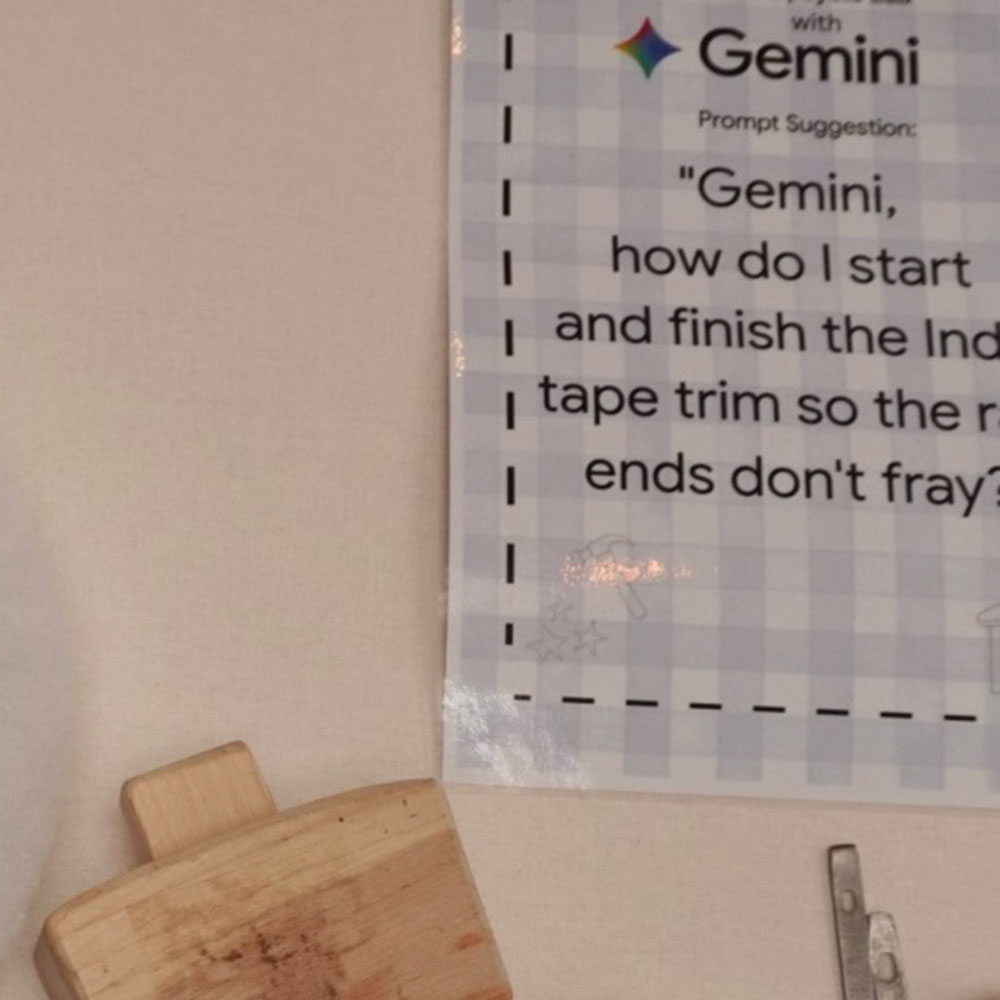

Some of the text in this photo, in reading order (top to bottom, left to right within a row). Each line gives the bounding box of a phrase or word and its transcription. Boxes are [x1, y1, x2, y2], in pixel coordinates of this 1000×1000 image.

[791, 13, 842, 32] with
[699, 26, 919, 86] Gemini
[698, 109, 917, 140] Prompt Suggestion:
[679, 165, 897, 219] "Gemini,
[611, 234, 972, 289] how do I start
[555, 305, 652, 345] and
[667, 306, 807, 352] finish
[821, 314, 908, 357] the
[537, 374, 1000, 433] tape trim so the r
[584, 451, 715, 495] ends
[730, 455, 867, 502] don't
